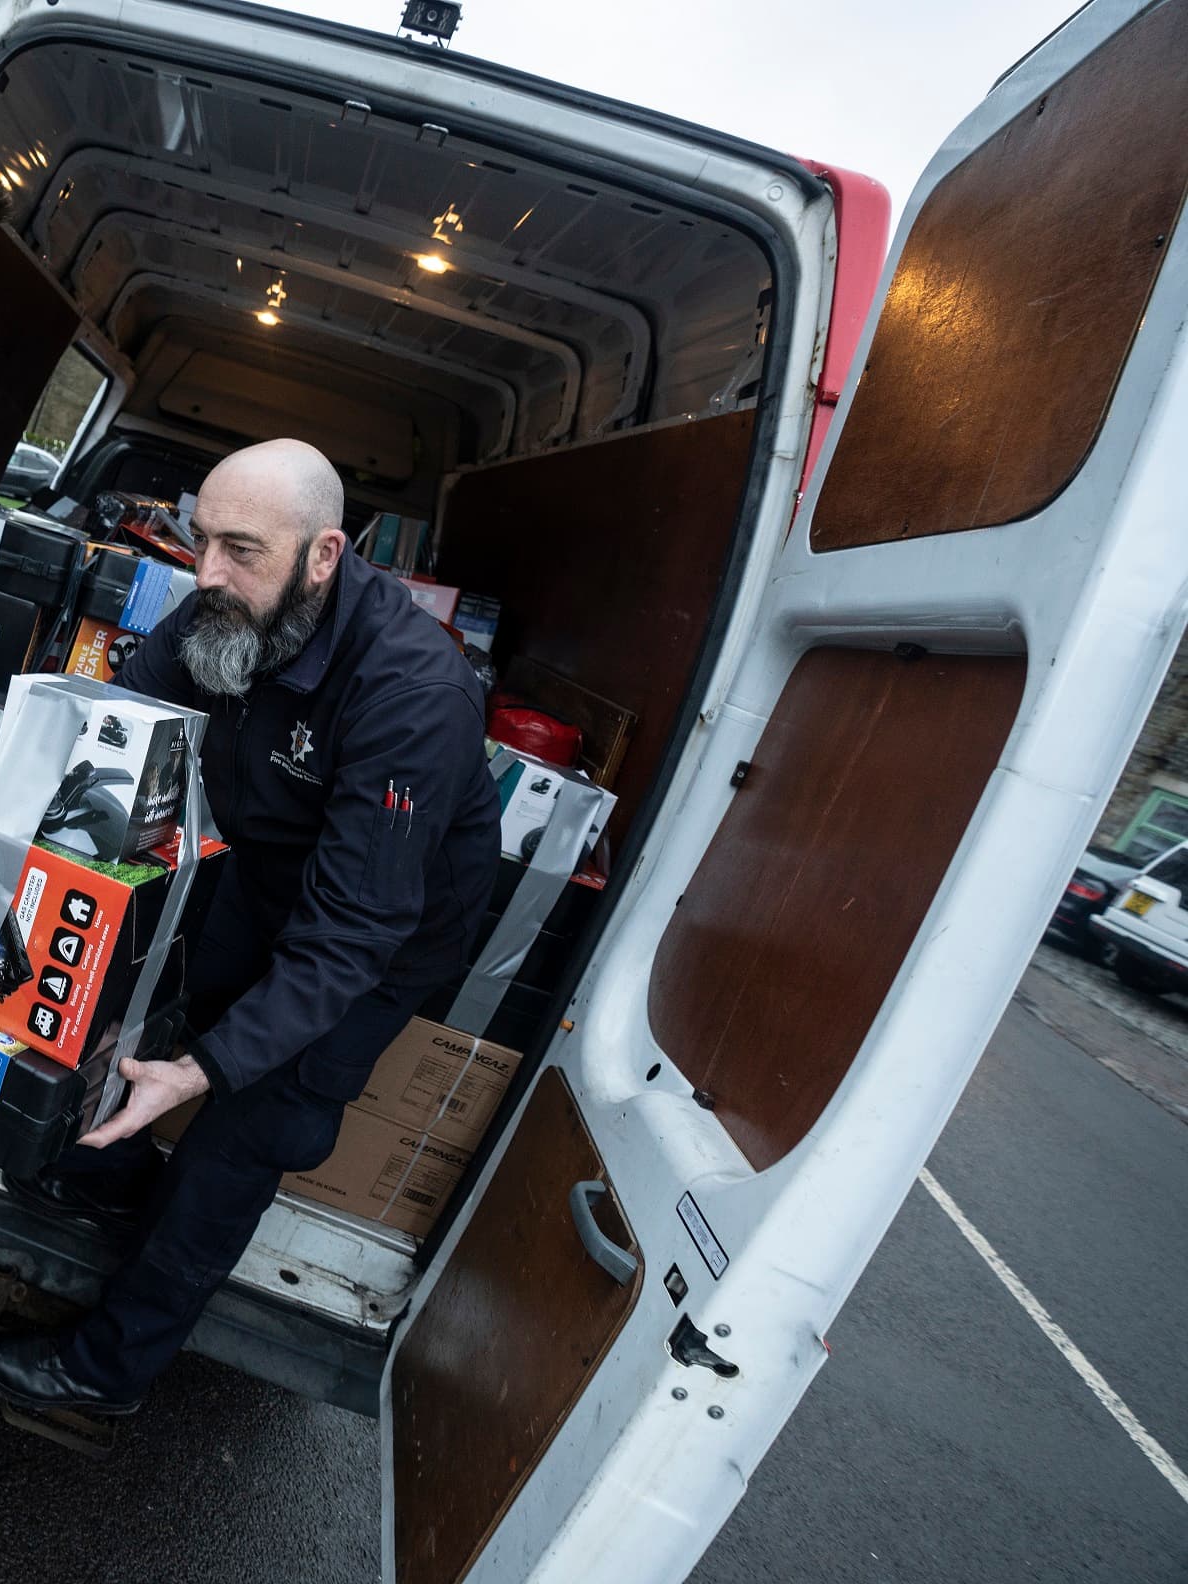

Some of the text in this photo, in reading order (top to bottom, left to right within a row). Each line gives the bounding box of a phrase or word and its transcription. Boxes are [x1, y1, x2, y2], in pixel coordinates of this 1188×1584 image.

[94, 909, 104, 929] Home
[81, 943, 93, 970] Camping
[75, 1001, 86, 1026] outdoor
